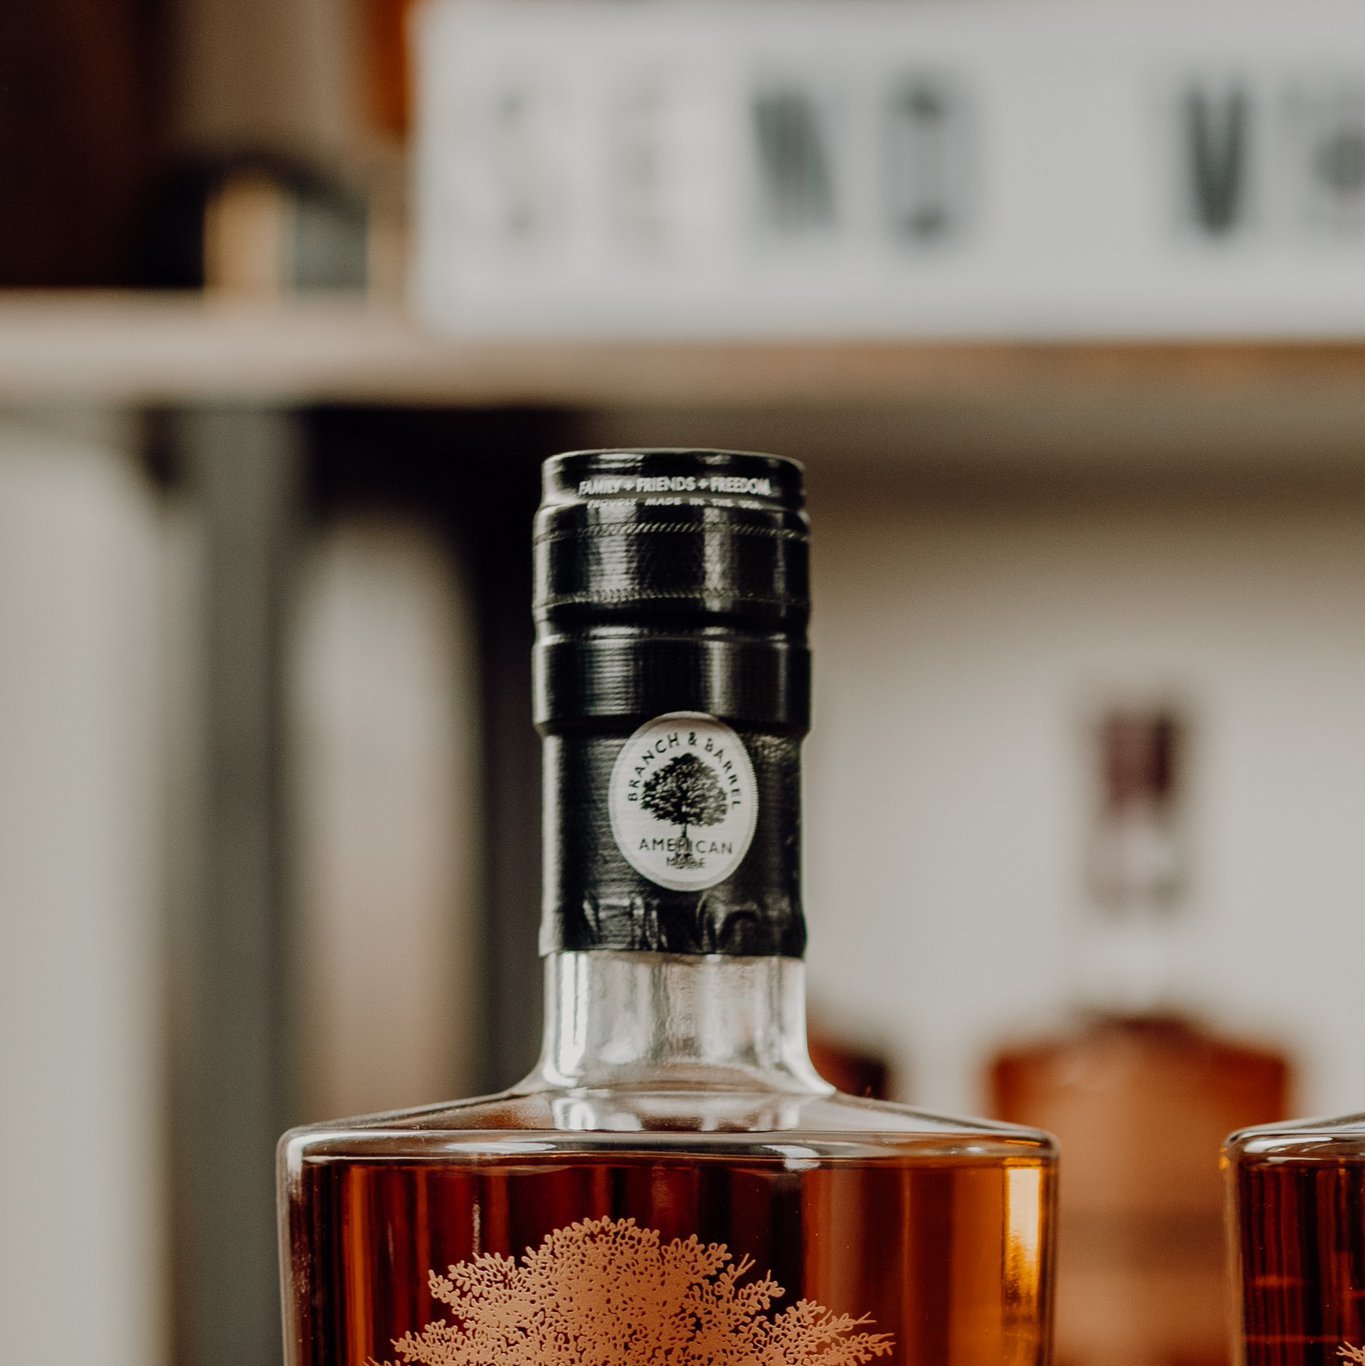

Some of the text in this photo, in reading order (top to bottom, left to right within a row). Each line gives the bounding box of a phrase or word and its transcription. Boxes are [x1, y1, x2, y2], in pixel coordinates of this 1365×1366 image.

[636, 477, 696, 493] FRIENDS
[711, 477, 771, 496] FREEDOM
[628, 732, 742, 809] BRANCH & BARREL
[639, 838, 732, 854] AMERICAN
